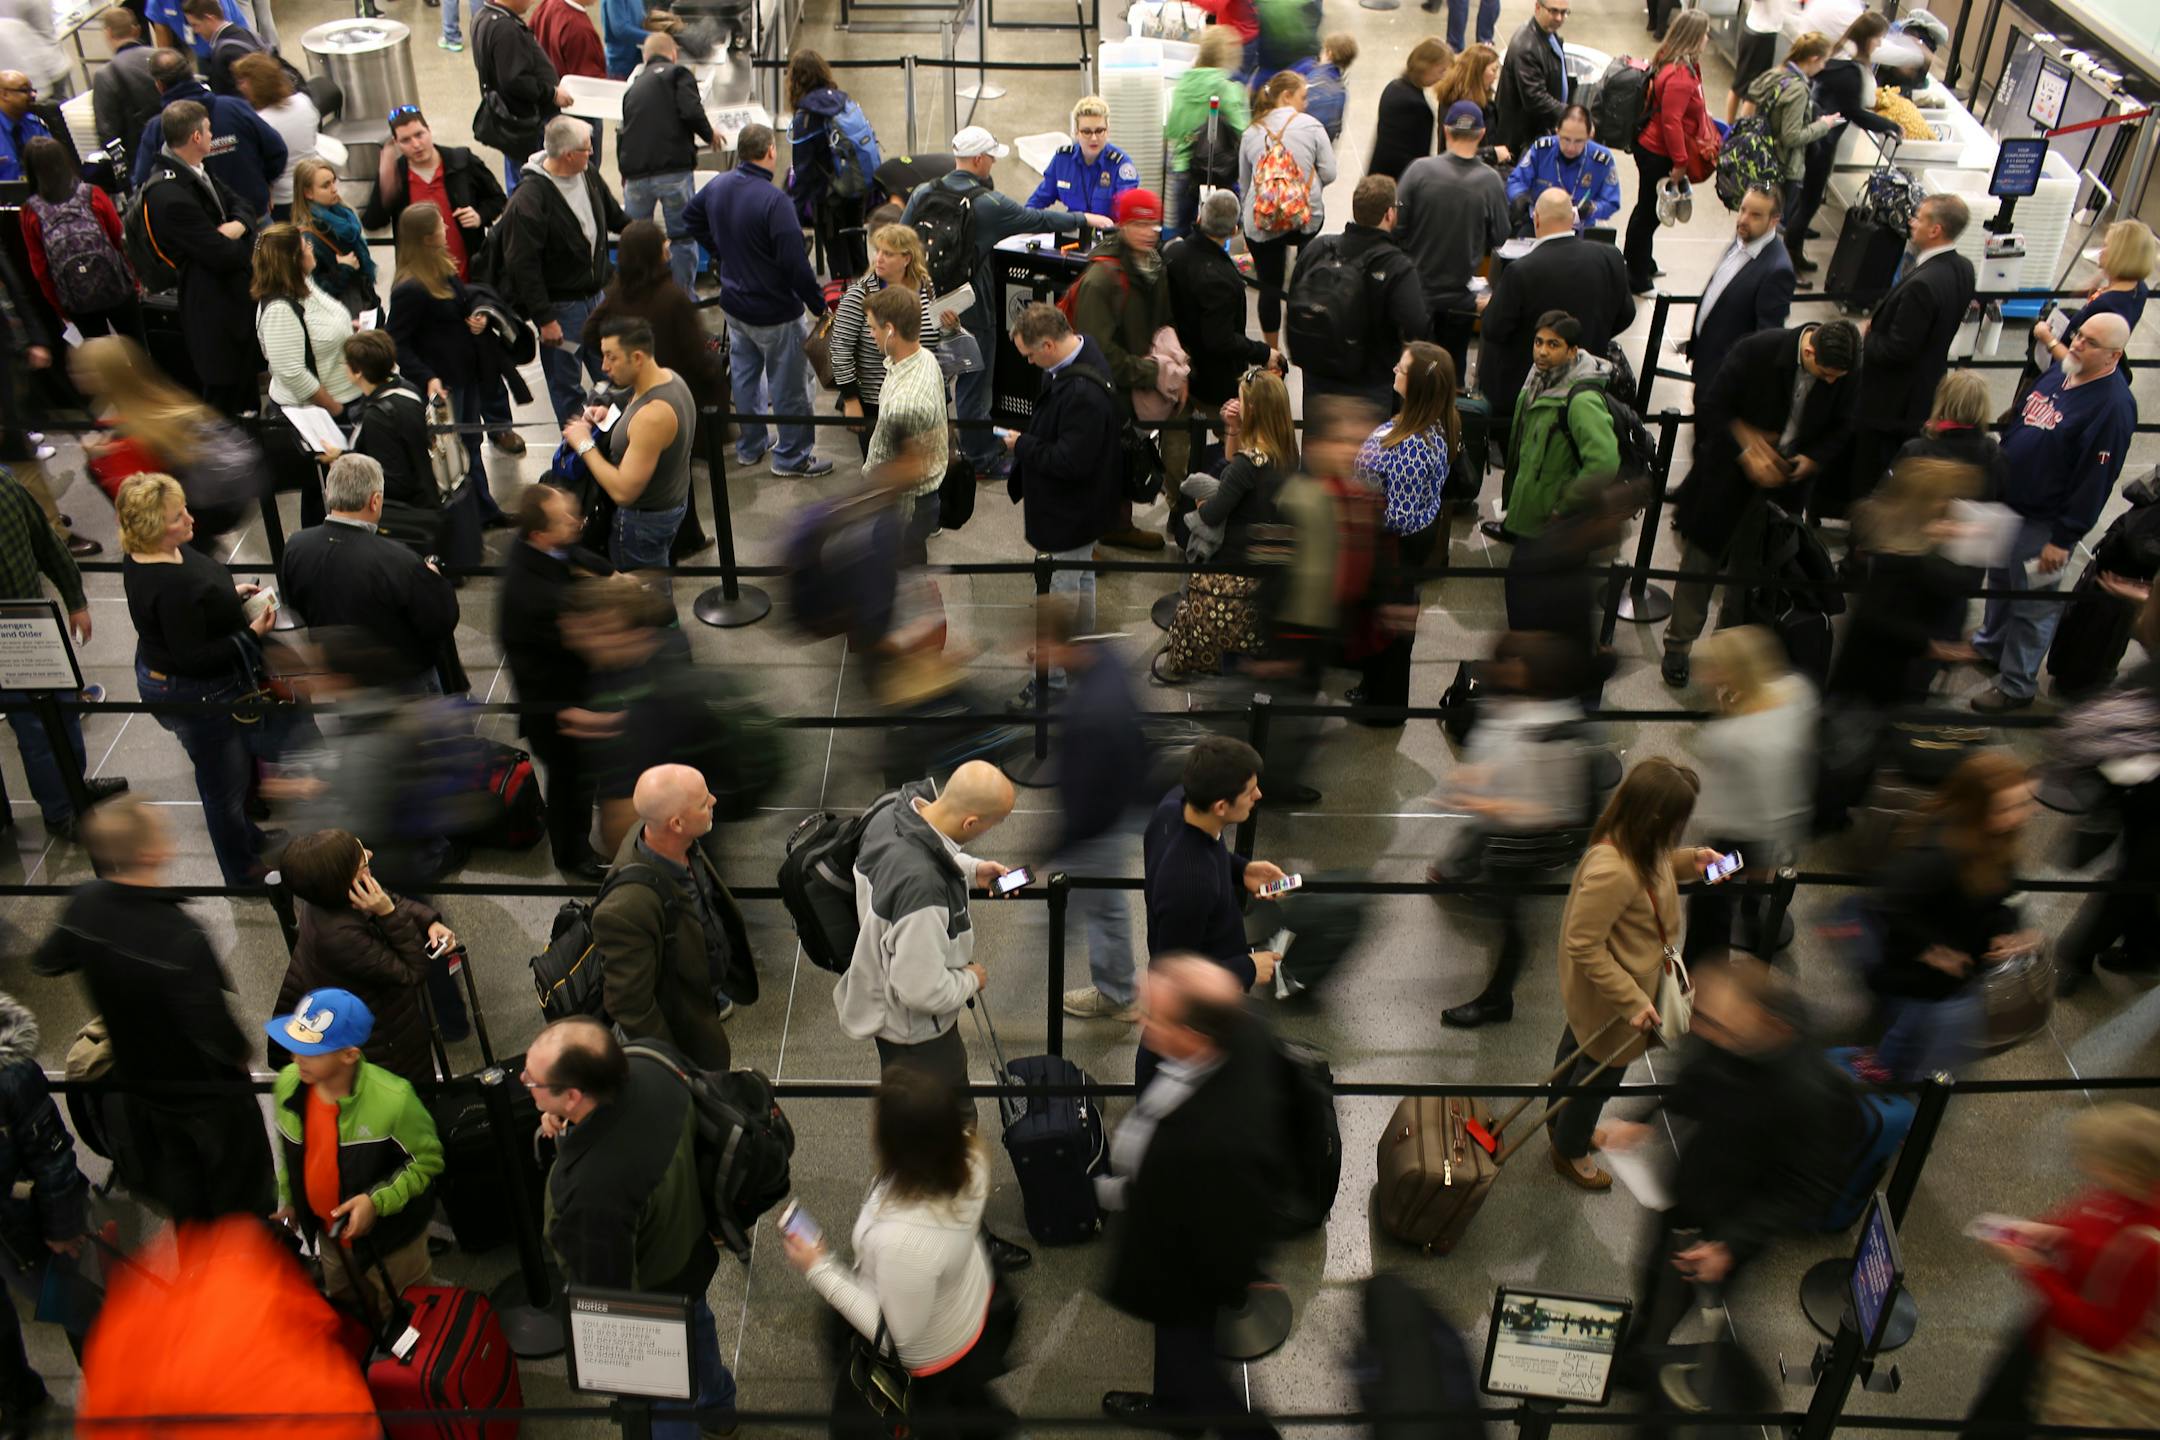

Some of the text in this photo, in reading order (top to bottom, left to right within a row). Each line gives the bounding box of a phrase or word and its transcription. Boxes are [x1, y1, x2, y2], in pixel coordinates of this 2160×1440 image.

[1997, 62, 2012, 103] Please
[2022, 390, 2063, 430] Twins
[576, 1300, 608, 1312] Notice
[620, 1323, 662, 1335] entering
[638, 1339, 655, 1348] and
